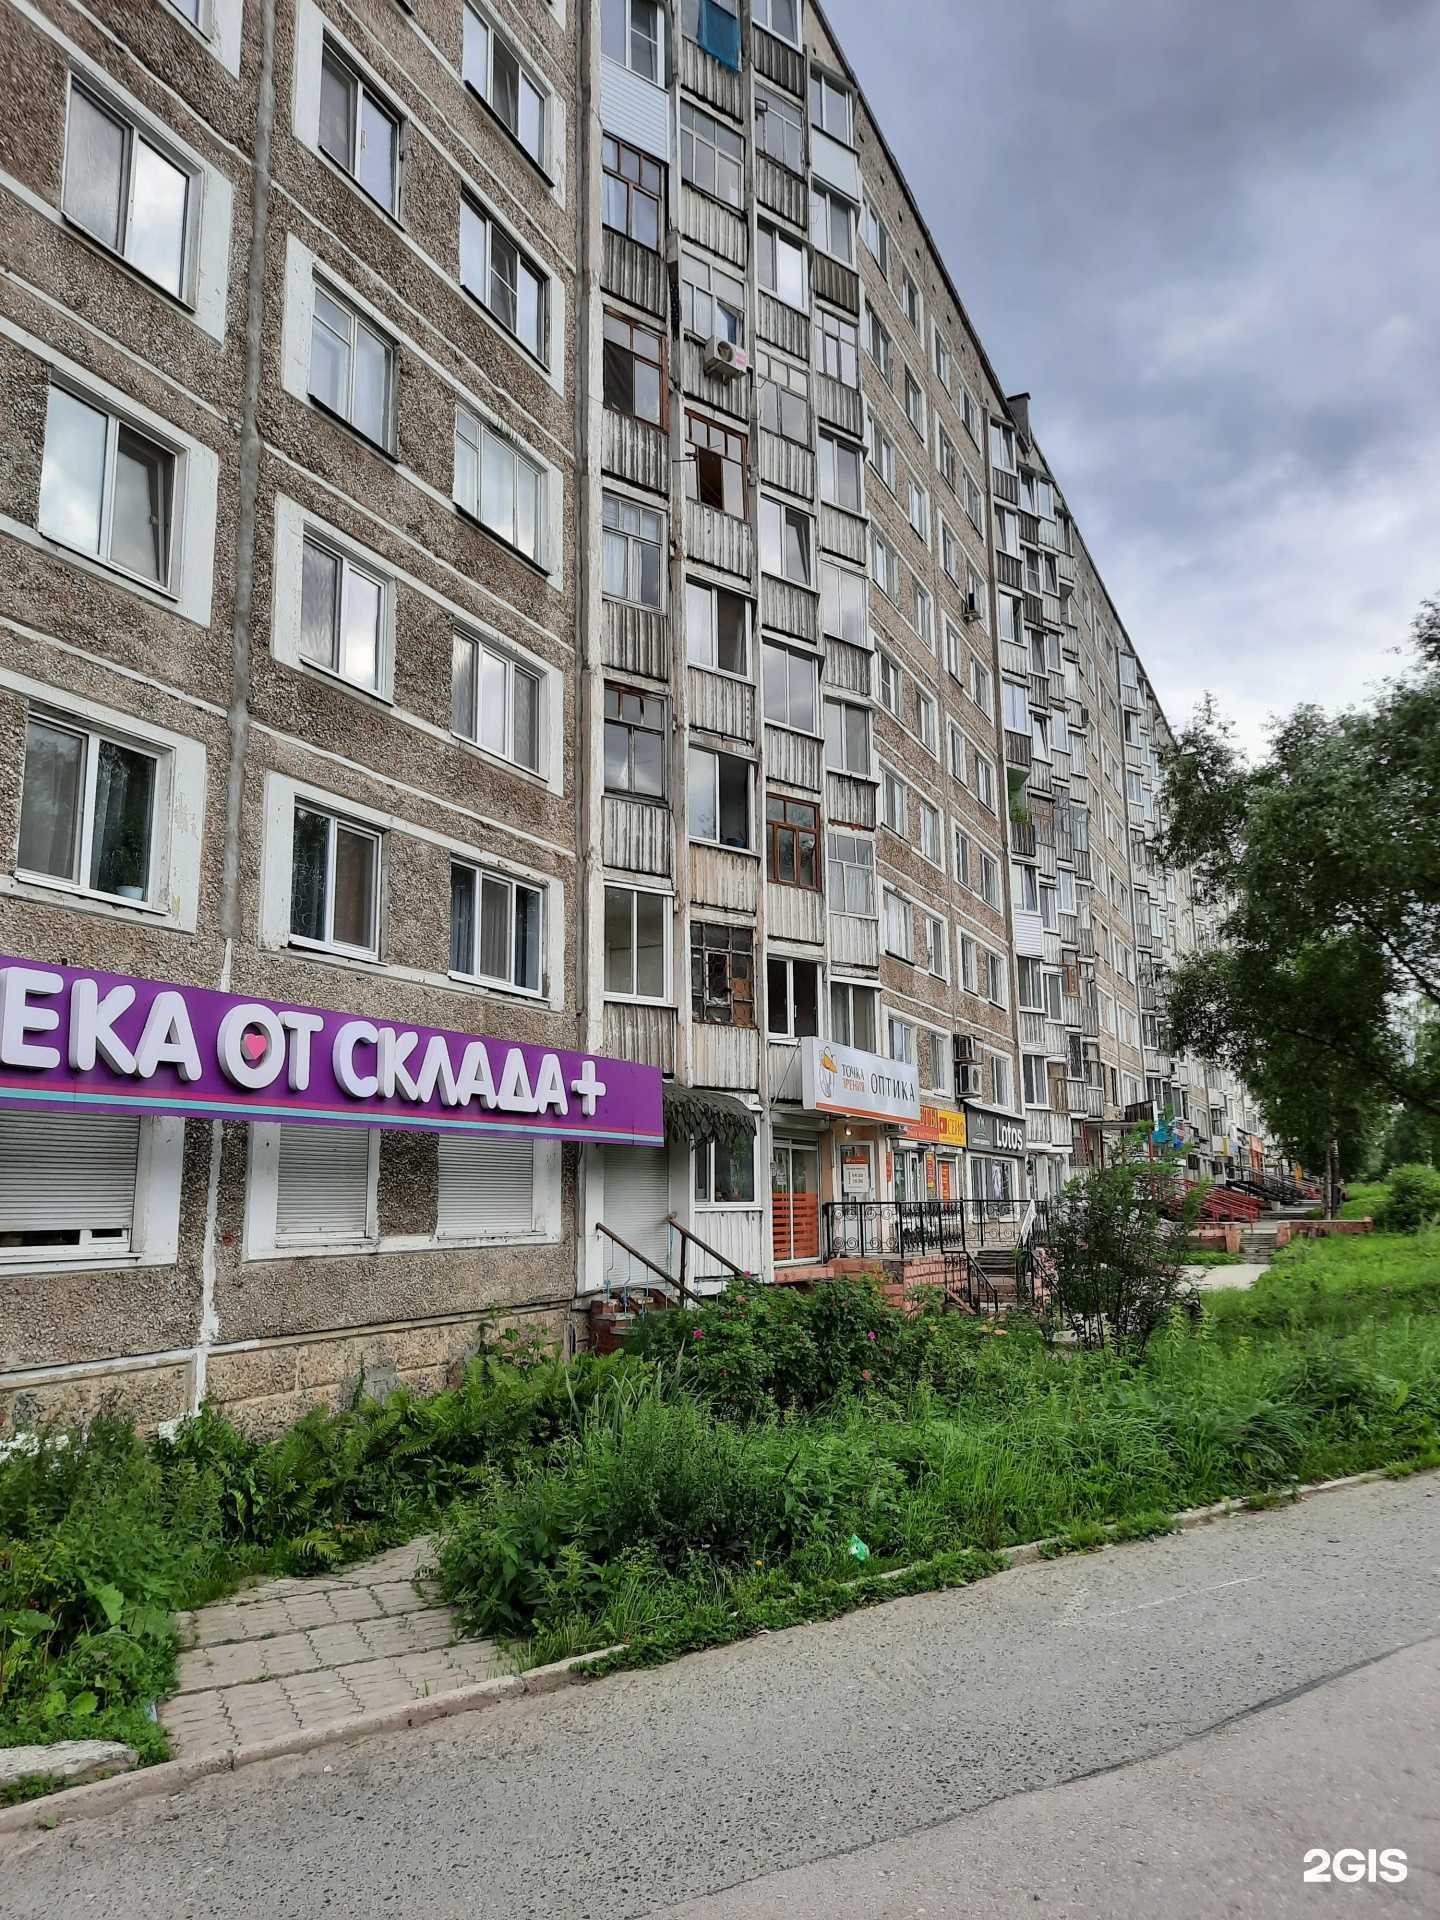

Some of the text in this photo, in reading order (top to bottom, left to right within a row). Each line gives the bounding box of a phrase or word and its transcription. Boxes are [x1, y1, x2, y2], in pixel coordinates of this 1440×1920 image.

[0, 966, 202, 1082] ЕКА
[217, 1003, 324, 1092] ОТ
[841, 1063, 865, 1081] ТОЧКА
[870, 1073, 915, 1102] ОПТИКА
[995, 1118, 1023, 1151] Lotos
